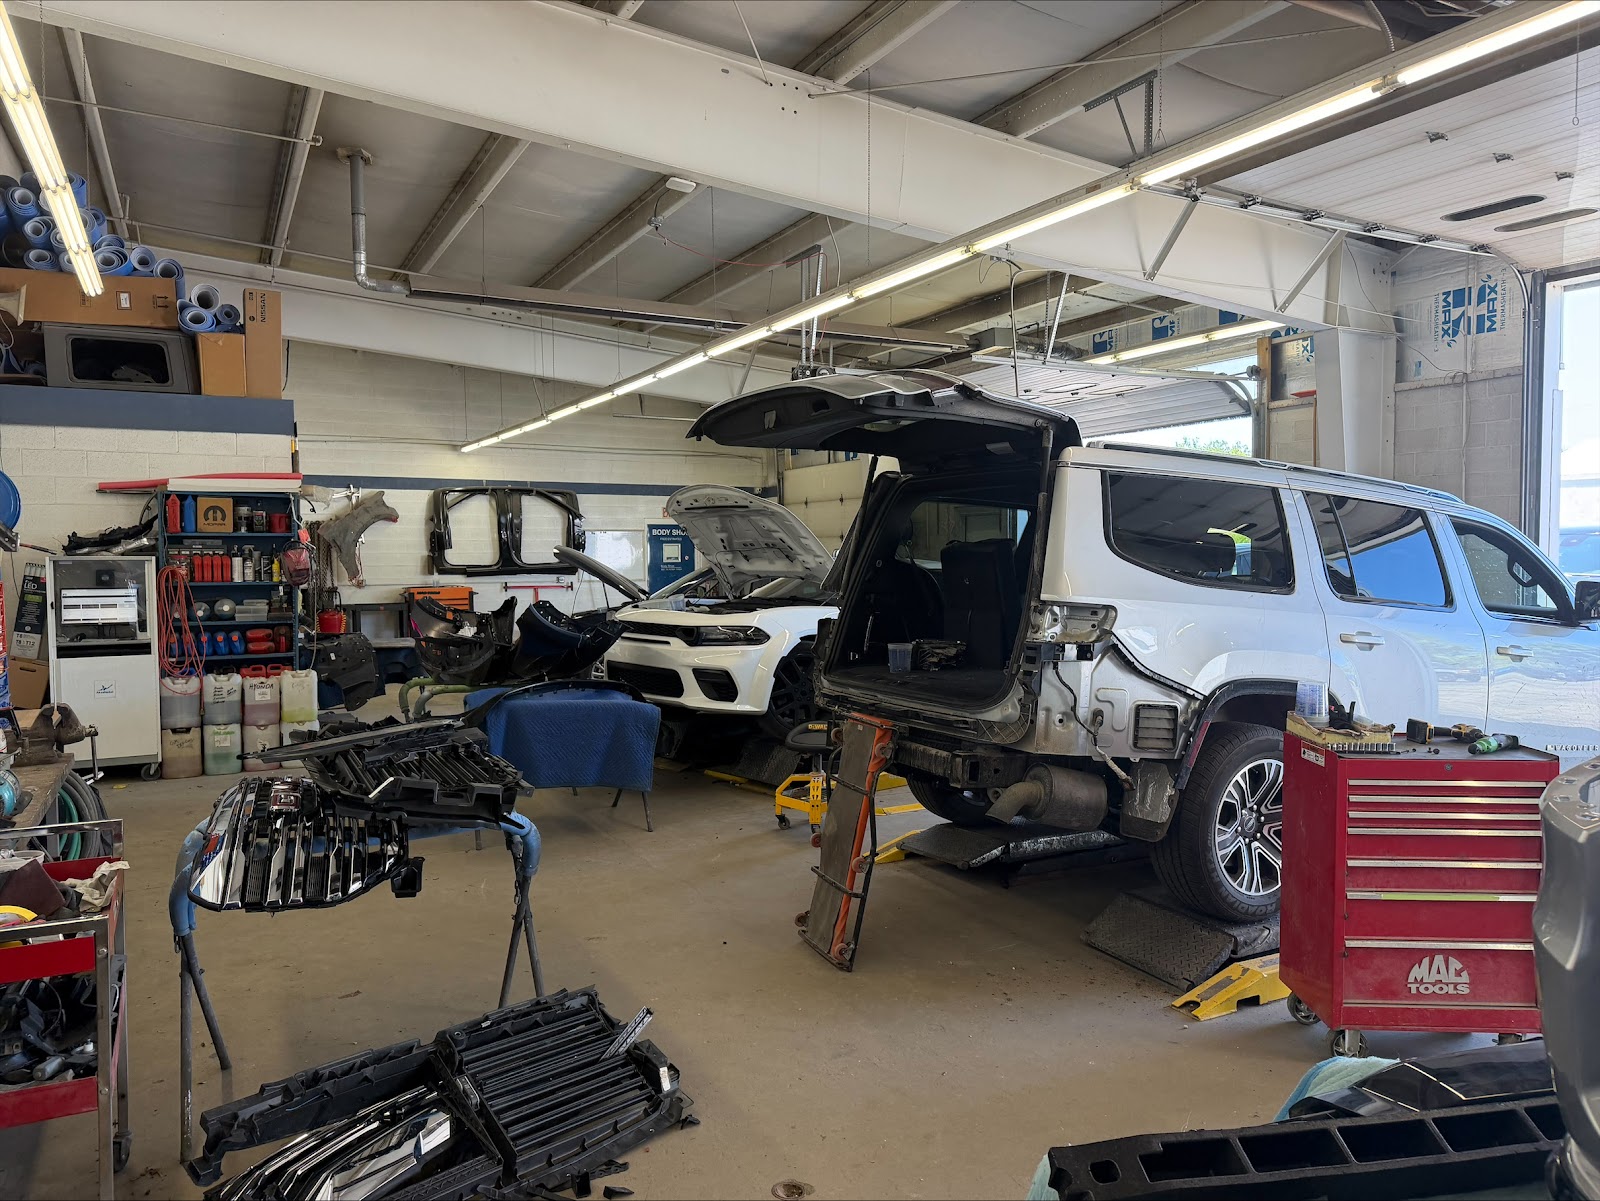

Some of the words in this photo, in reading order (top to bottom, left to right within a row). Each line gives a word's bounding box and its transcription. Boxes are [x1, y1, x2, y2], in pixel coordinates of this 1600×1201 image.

[1441, 290, 1452, 339] MAX
[1486, 282, 1498, 333] MAX
[1407, 955, 1470, 983] MAC
[1407, 983, 1471, 995] TOOLS
